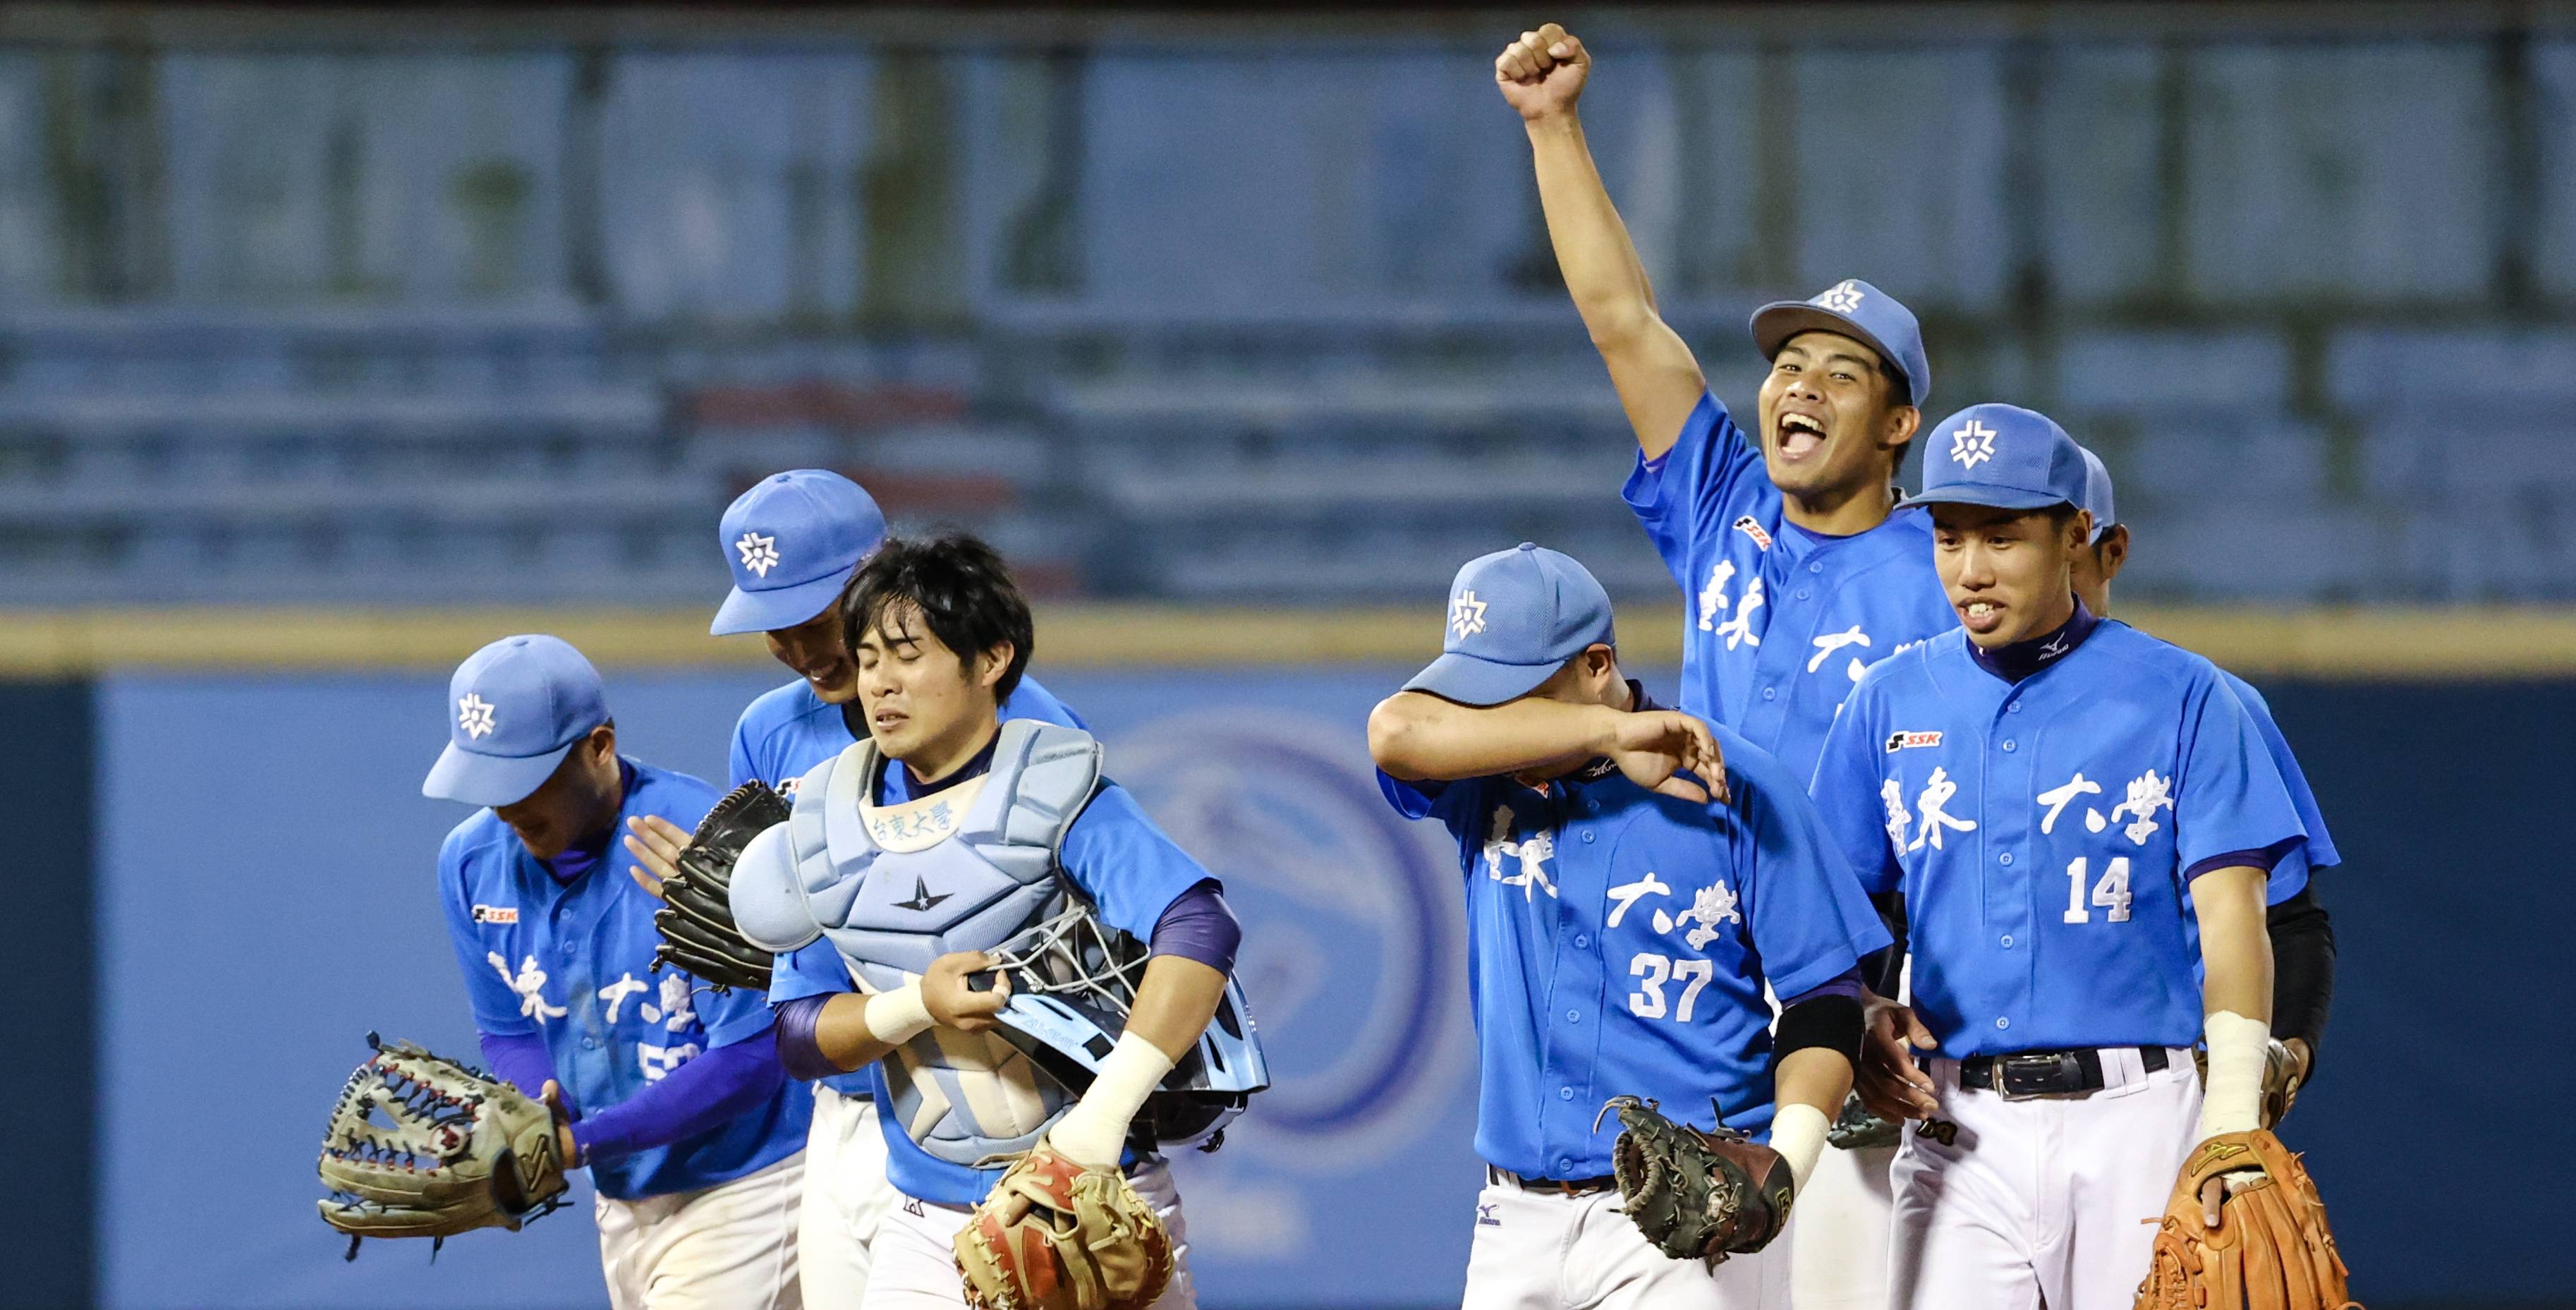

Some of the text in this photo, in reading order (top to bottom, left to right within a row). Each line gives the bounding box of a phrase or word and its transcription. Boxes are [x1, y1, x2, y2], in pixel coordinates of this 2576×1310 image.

[1906, 734, 1939, 745] SSK
[2063, 857, 2132, 923] 14
[1629, 952, 1713, 1022] 37
